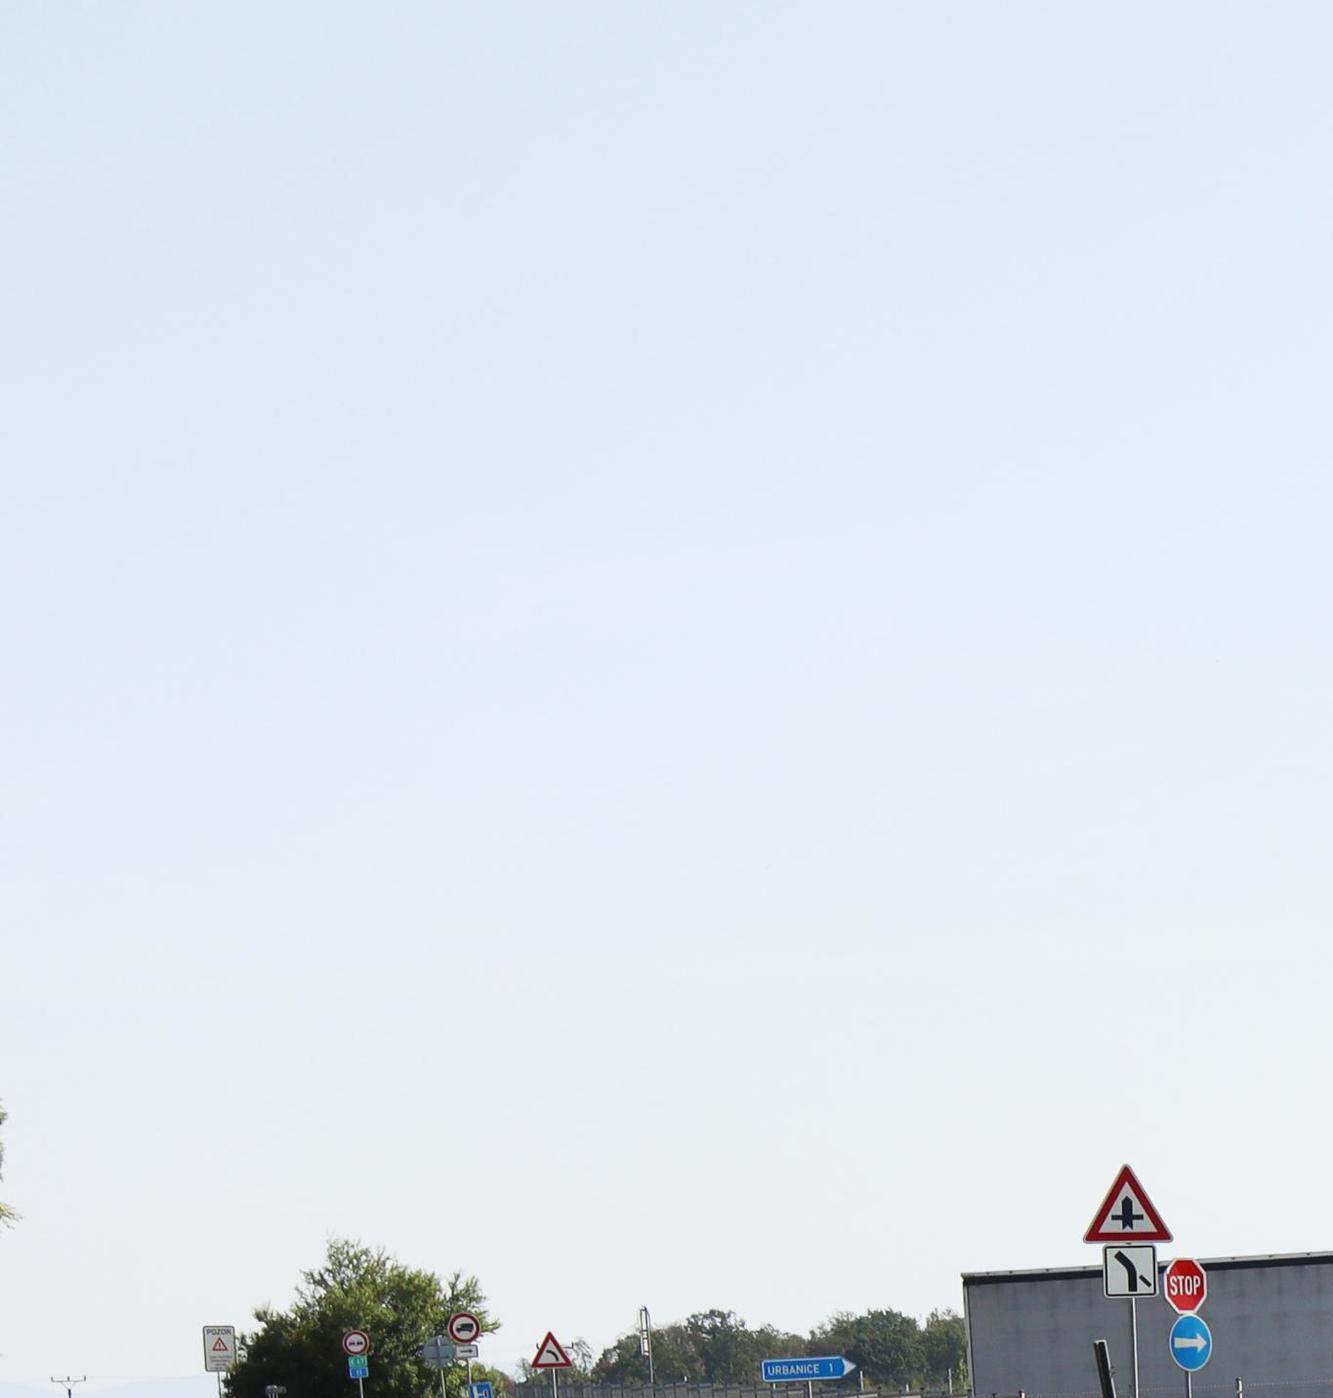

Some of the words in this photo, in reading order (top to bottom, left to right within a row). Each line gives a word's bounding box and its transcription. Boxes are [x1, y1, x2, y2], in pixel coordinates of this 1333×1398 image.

[1170, 1276, 1201, 1295] STOP
[767, 1363, 821, 1376] URBANICE
[828, 1362, 834, 1374] 1
